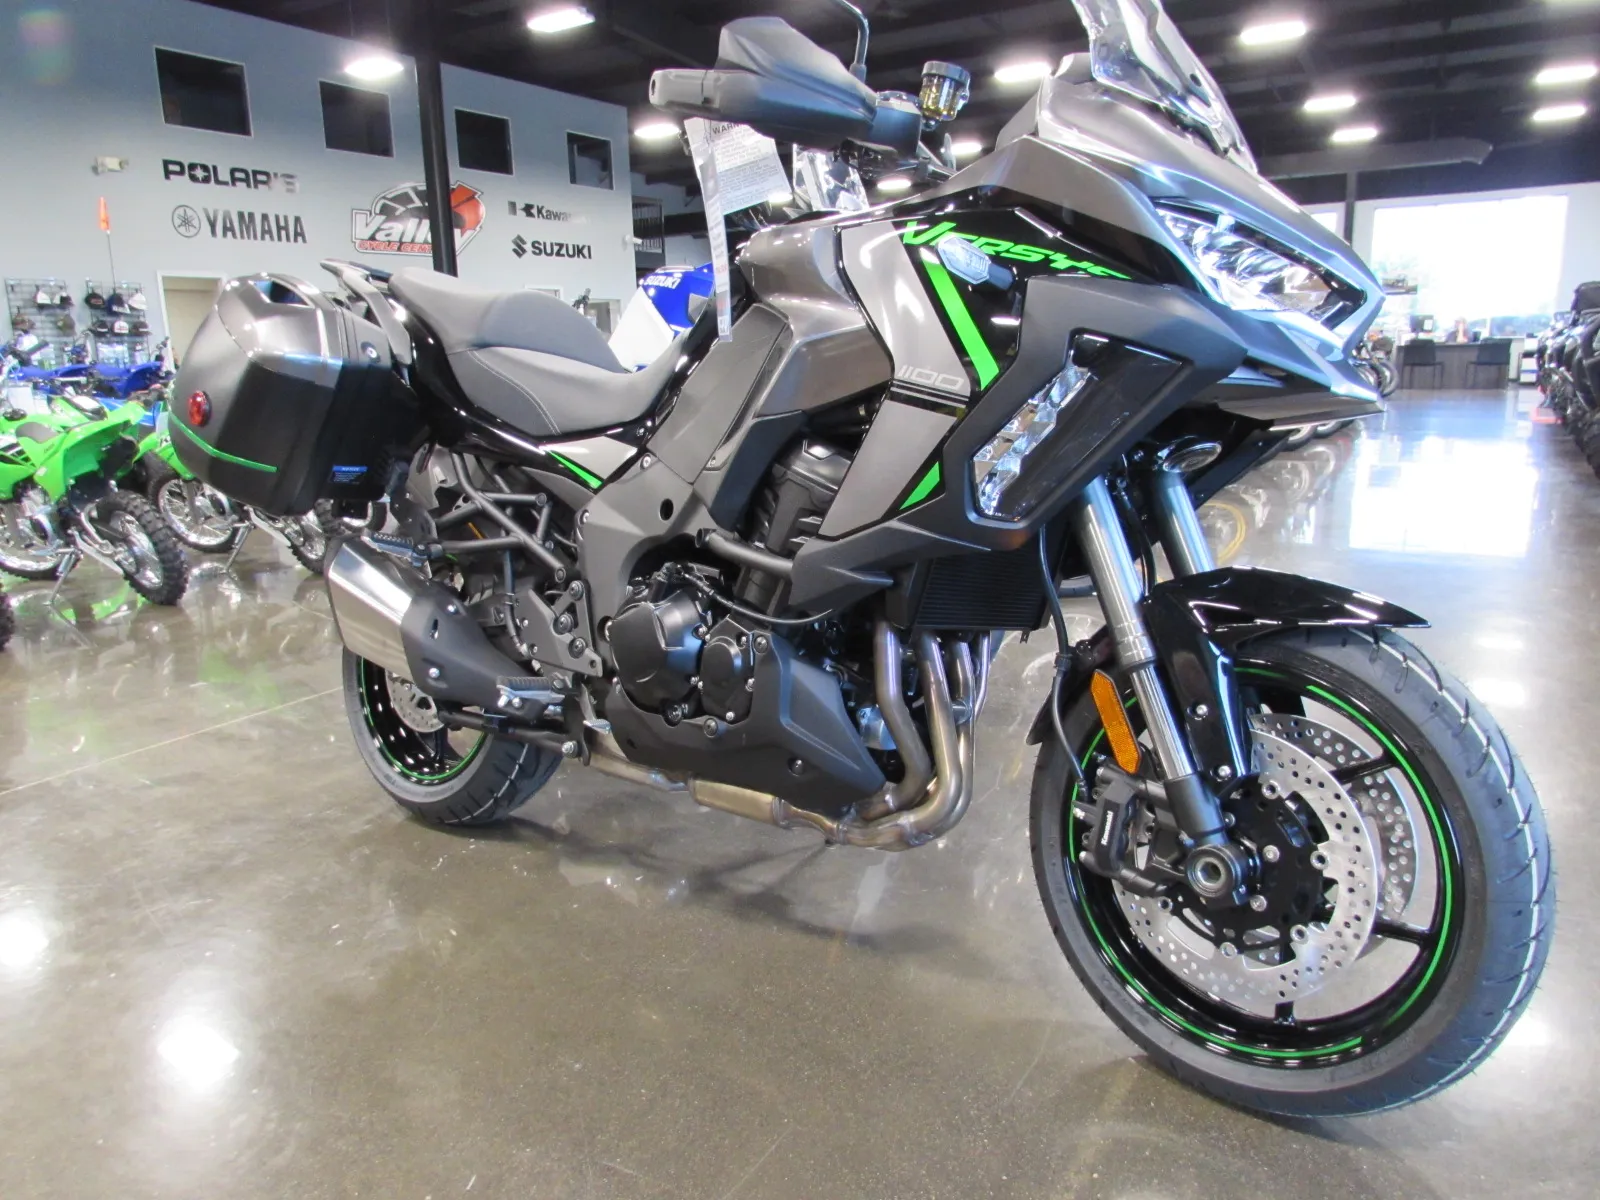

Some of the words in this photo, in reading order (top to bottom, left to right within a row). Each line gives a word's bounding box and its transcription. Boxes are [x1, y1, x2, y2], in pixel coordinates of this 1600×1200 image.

[202, 206, 308, 244] YAMAHA
[354, 211, 477, 256] Vally
[360, 240, 399, 252] CYCLE
[531, 240, 592, 260] SUZUKI
[643, 275, 682, 290] SUZUKI
[897, 364, 965, 390] 1100
